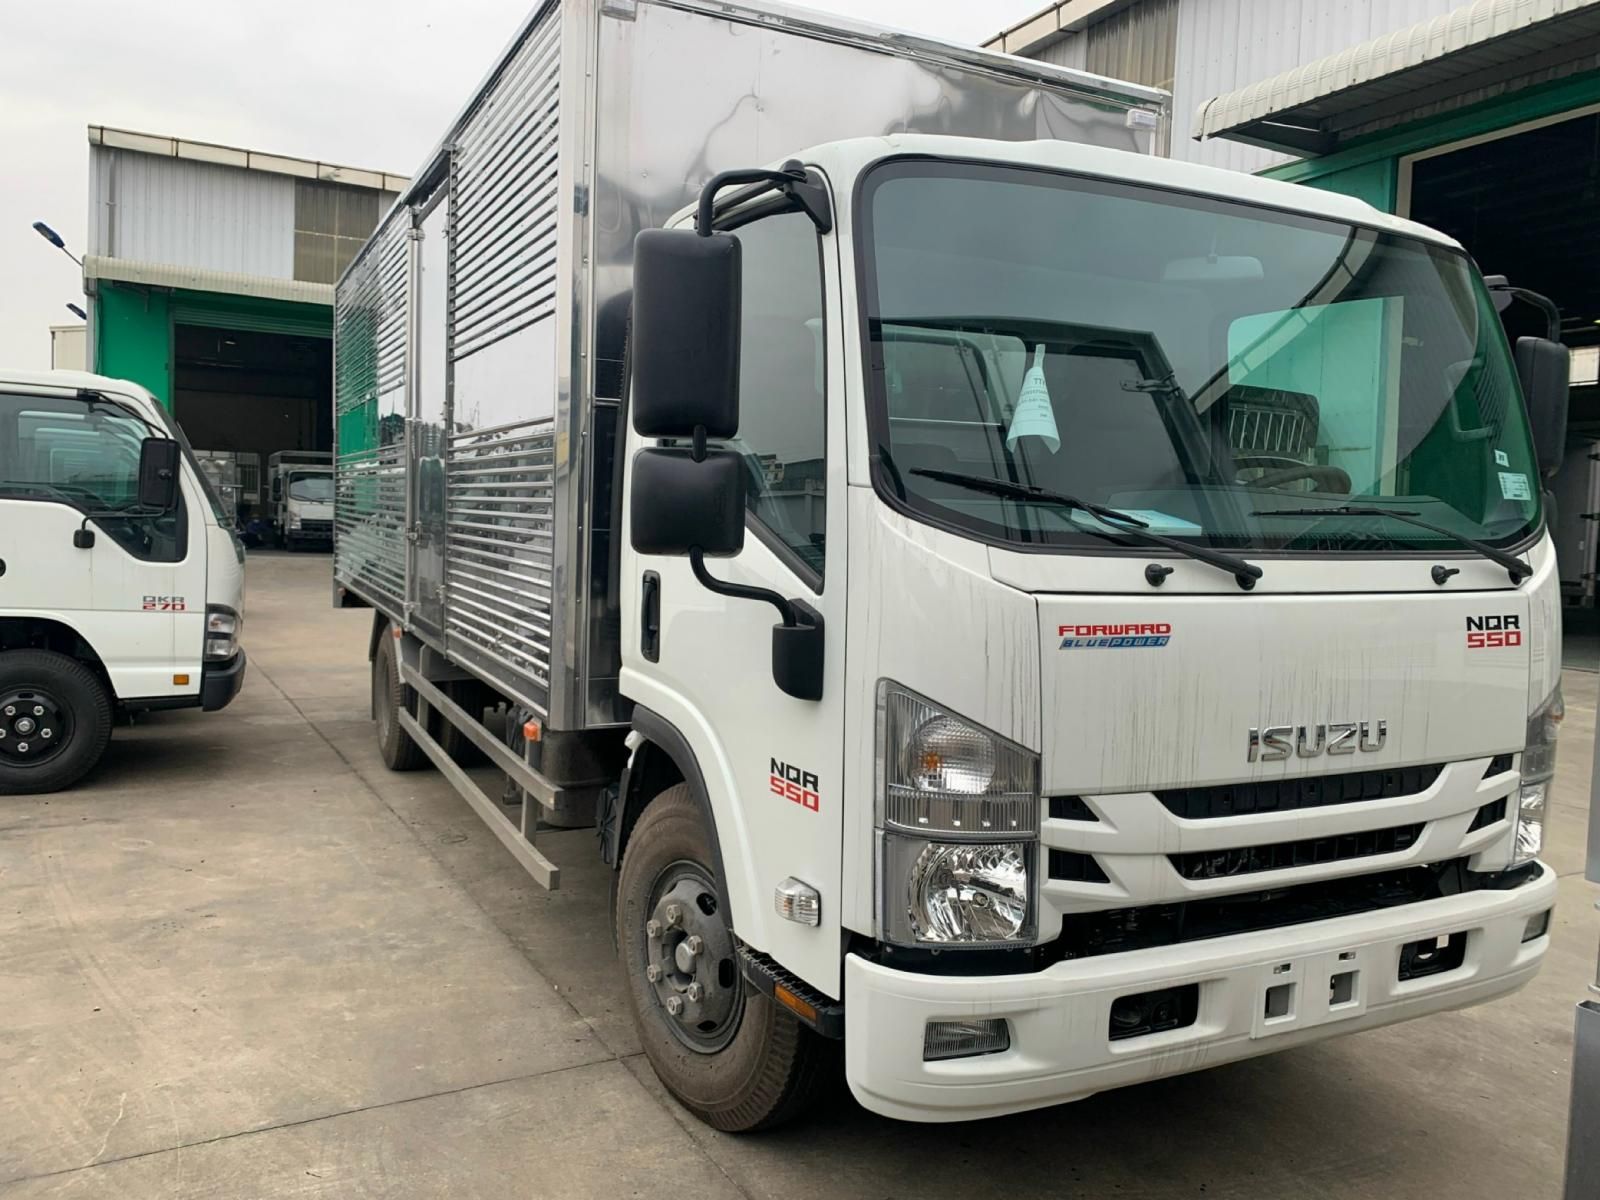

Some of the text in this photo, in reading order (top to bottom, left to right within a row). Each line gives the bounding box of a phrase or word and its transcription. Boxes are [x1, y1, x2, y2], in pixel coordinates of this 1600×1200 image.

[143, 595, 185, 603] QKR
[143, 603, 185, 611] 270
[1059, 623, 1171, 636] FORWARD
[1466, 614, 1520, 631] NQR
[1060, 636, 1170, 649] BLUEPOWER
[1467, 631, 1521, 648] 550
[1247, 720, 1387, 762] ISUZU
[771, 757, 819, 793] NQR
[770, 775, 819, 812] 550
